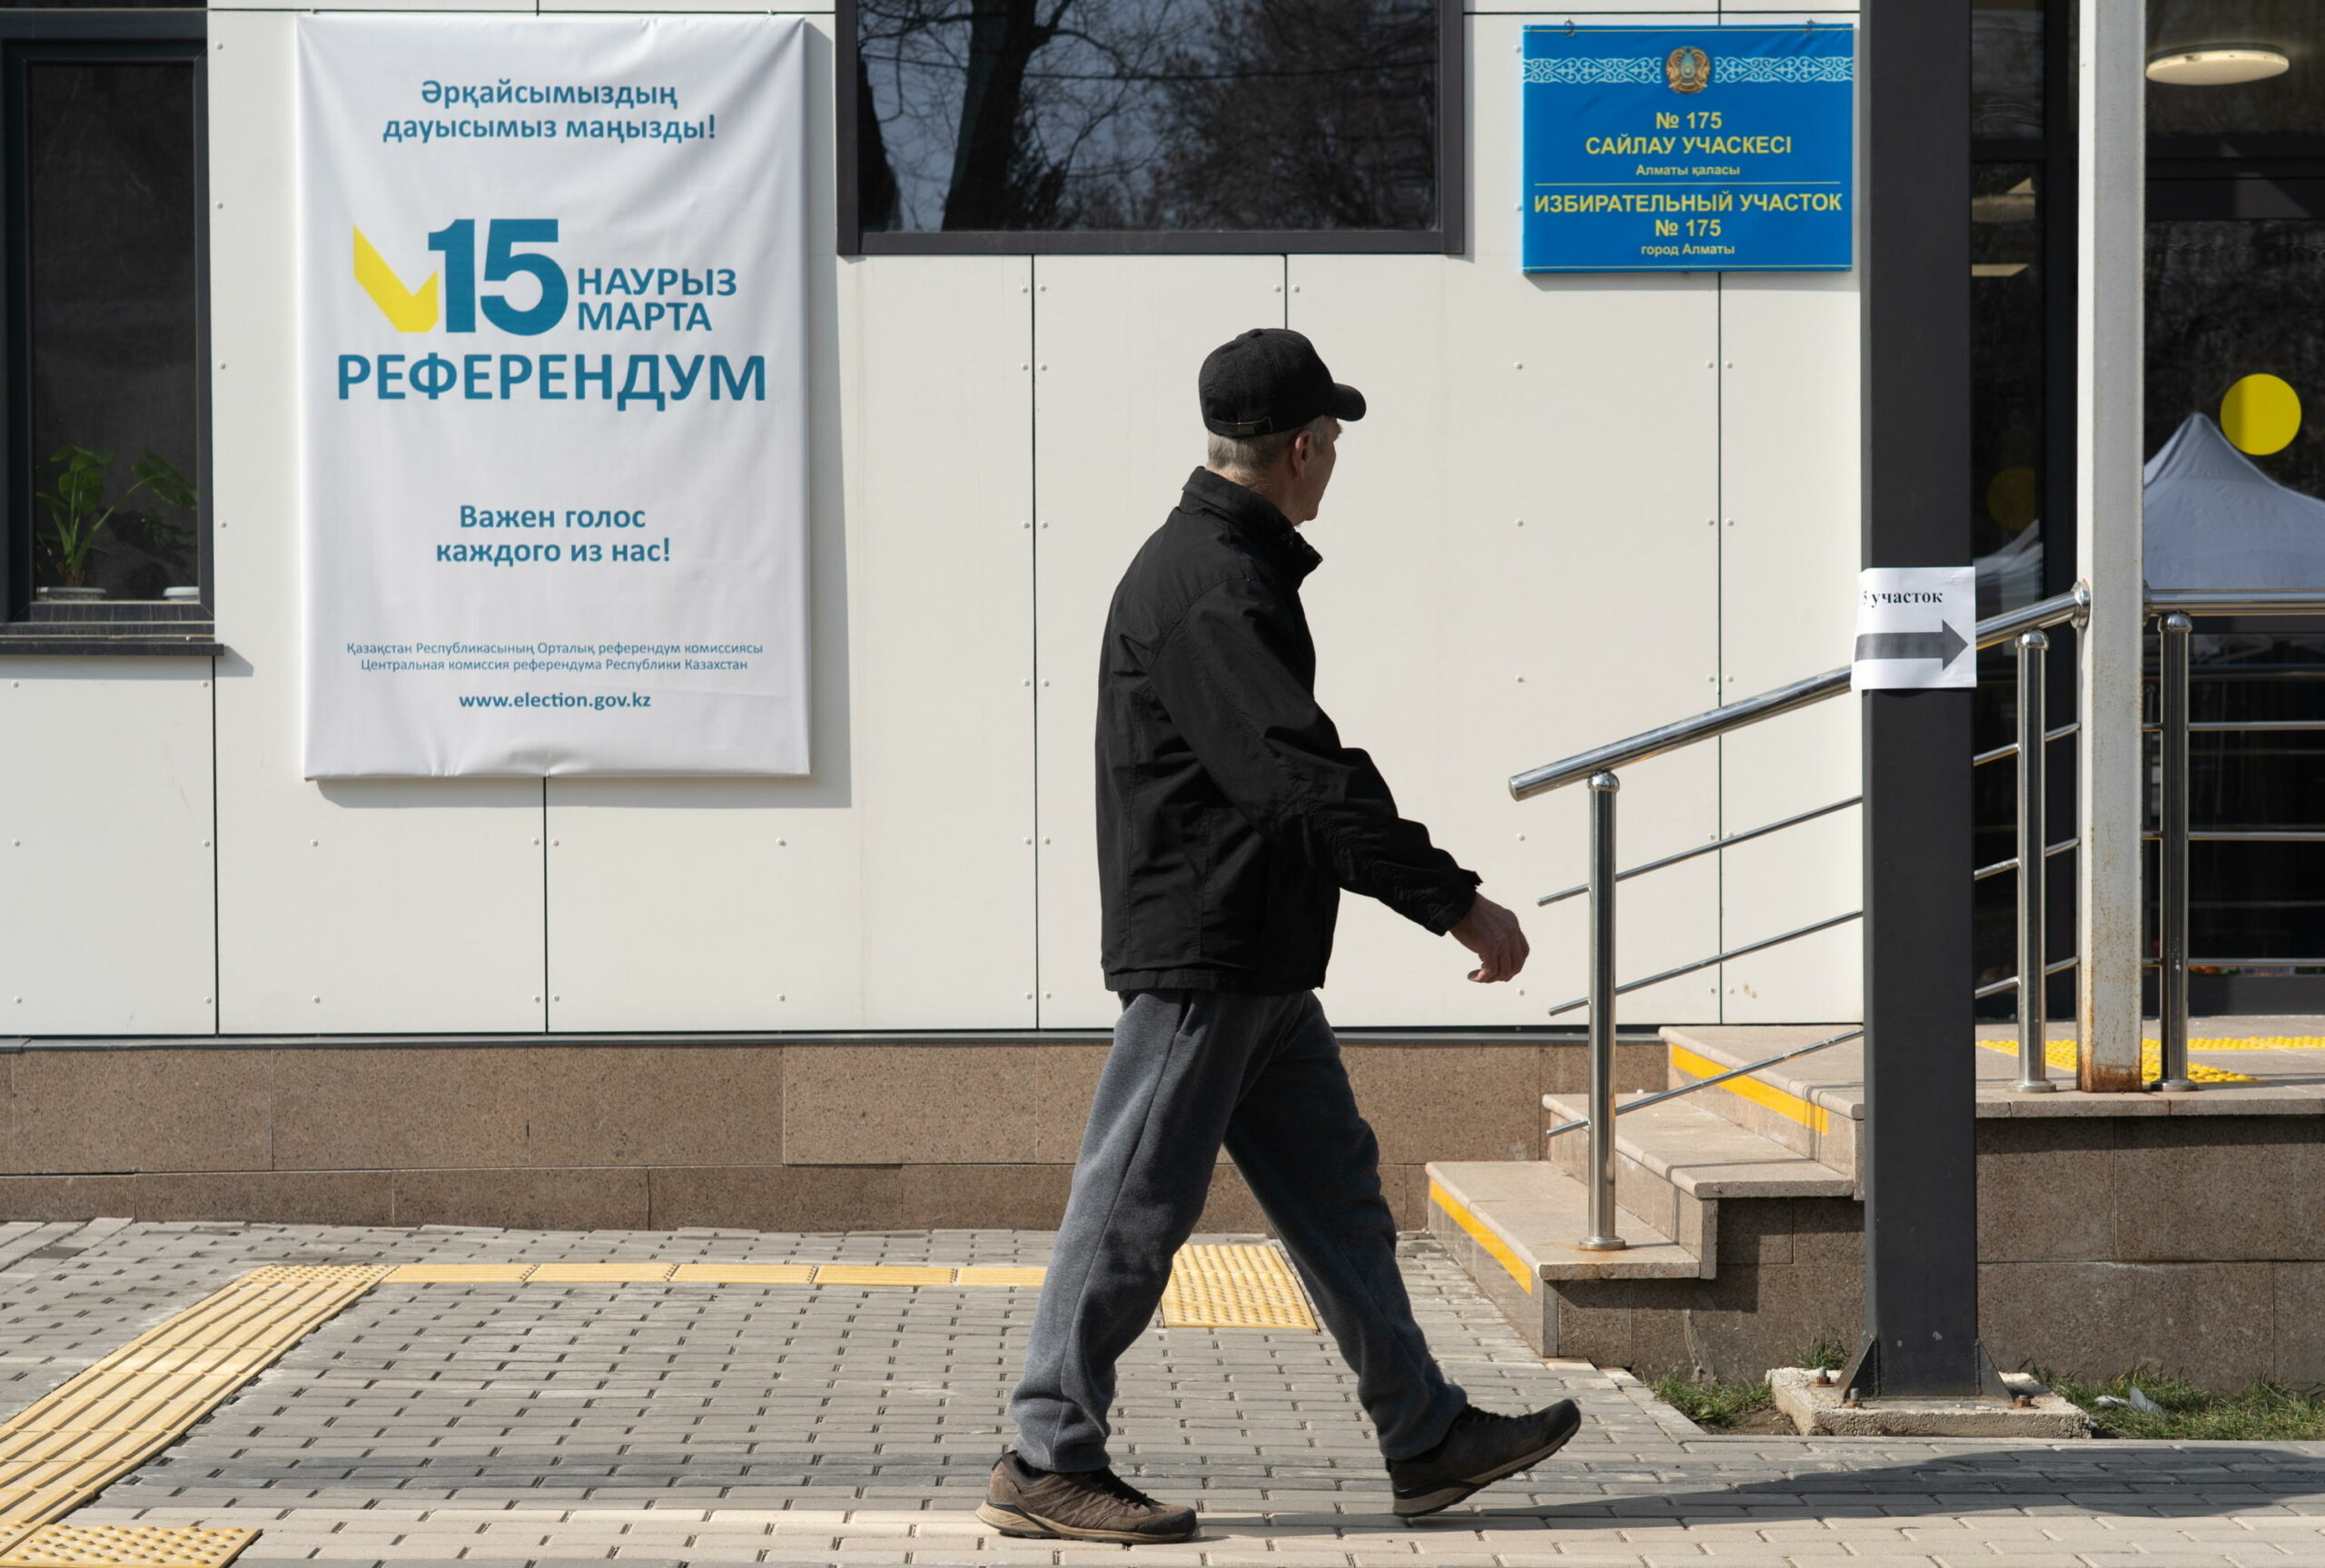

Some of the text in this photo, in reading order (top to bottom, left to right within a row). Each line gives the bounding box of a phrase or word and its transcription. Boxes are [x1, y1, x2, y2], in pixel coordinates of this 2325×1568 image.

[420, 79, 678, 110] Әрқайсымыздың
[381, 113, 717, 143] дауысымыз маңызды!
[1655, 111, 1724, 130] № 175
[1584, 133, 1793, 155] САЙЛАУ УЧАСКЕСІ
[1635, 164, 1742, 176] Алматы қаласы
[1533, 190, 1844, 213] ИЗБИРАТЕЛЬНЫЙ УЧАСТОК
[1654, 218, 1722, 237] № 175
[1640, 244, 1736, 257] город Алматы
[427, 218, 569, 337] 15
[577, 268, 737, 297] НАУРЫЗ
[577, 301, 713, 331] МАРТА
[337, 352, 767, 412] РЕФЕРЕНДУМ
[459, 504, 647, 529] Важен голос
[435, 537, 671, 567] каждого из нас!
[1871, 592, 1943, 608] участок
[347, 642, 764, 659] Қазақстан Республикасының Орталық референдум комиссиясы
[361, 657, 748, 675] Центральная комиссия референдума Республики Казахстан
[459, 691, 652, 711] www.election.gov.kz
